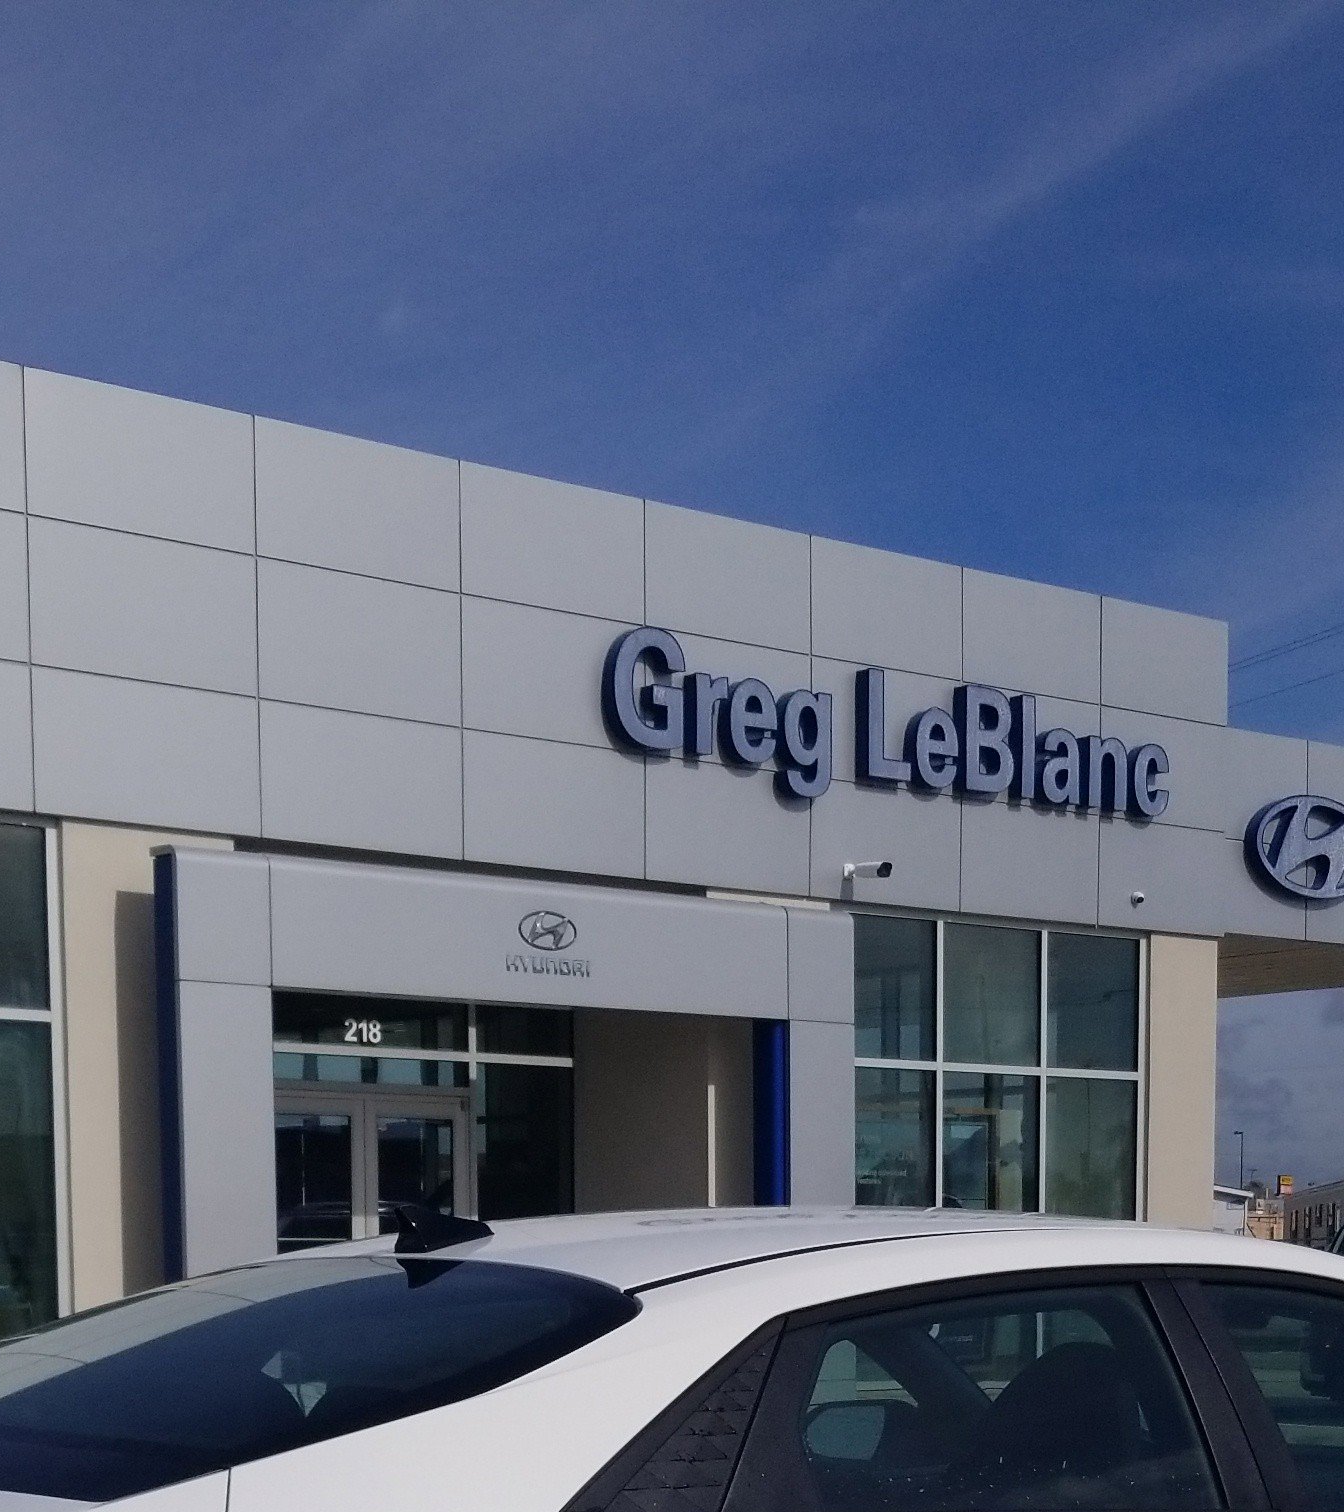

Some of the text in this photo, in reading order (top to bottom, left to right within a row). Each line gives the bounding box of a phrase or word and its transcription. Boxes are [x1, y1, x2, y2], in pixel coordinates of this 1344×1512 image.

[604, 626, 1170, 818] Greg LeBlanc
[505, 954, 591, 978] HYUNDAI
[344, 1018, 381, 1044] 218
